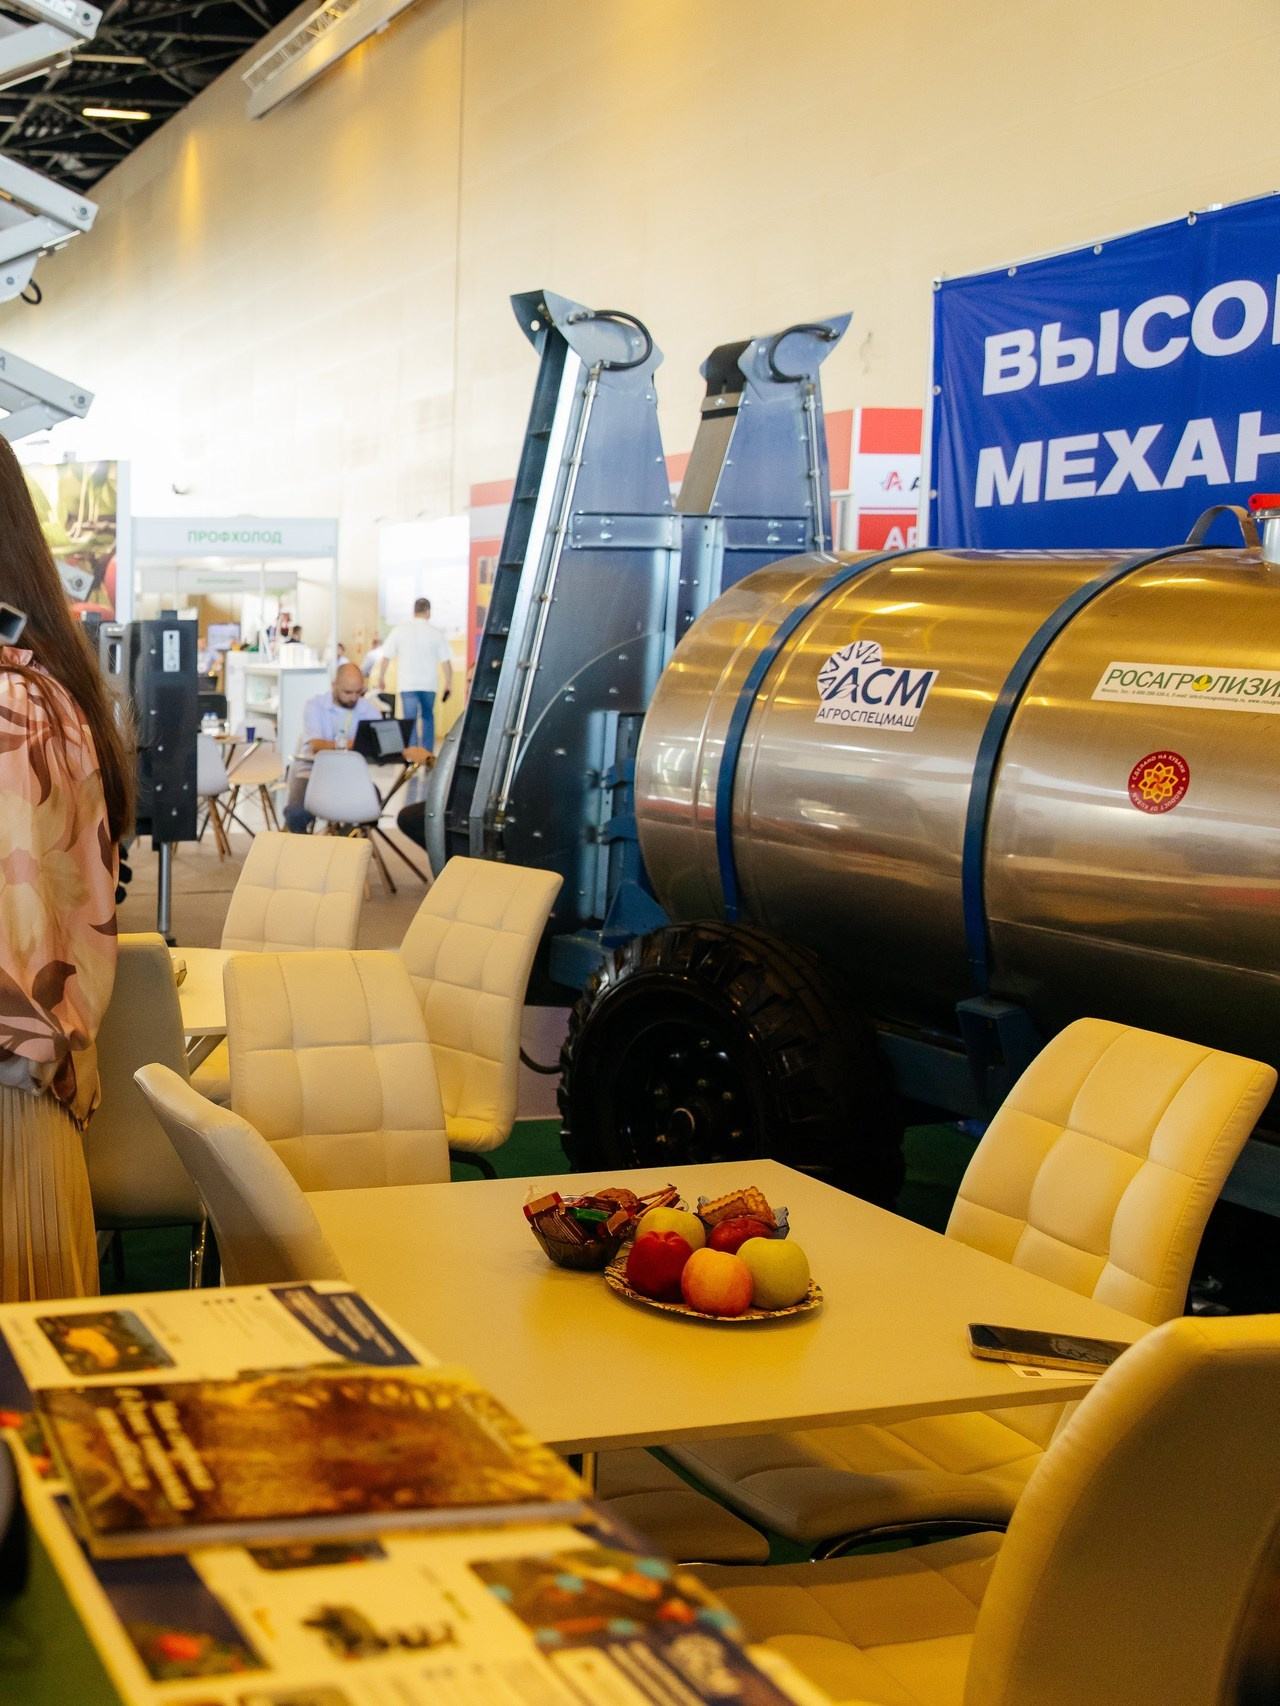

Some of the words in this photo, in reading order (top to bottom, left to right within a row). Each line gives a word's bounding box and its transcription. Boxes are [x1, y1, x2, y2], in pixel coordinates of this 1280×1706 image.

[982, 271, 1280, 396] ВЫСО
[187, 531, 282, 545] ПРОФХОЛОД
[824, 667, 934, 709] АСМ
[1105, 668, 1280, 698] РОСАГРОЛИЗИ
[817, 708, 918, 728] АГРОСПЕЦМАШ
[1132, 756, 1157, 780] СДЕЛАНО
[1168, 755, 1186, 773] КУБАНИ
[1132, 792, 1149, 810] KUBAN
[1160, 786, 1185, 811] PRODUCT
